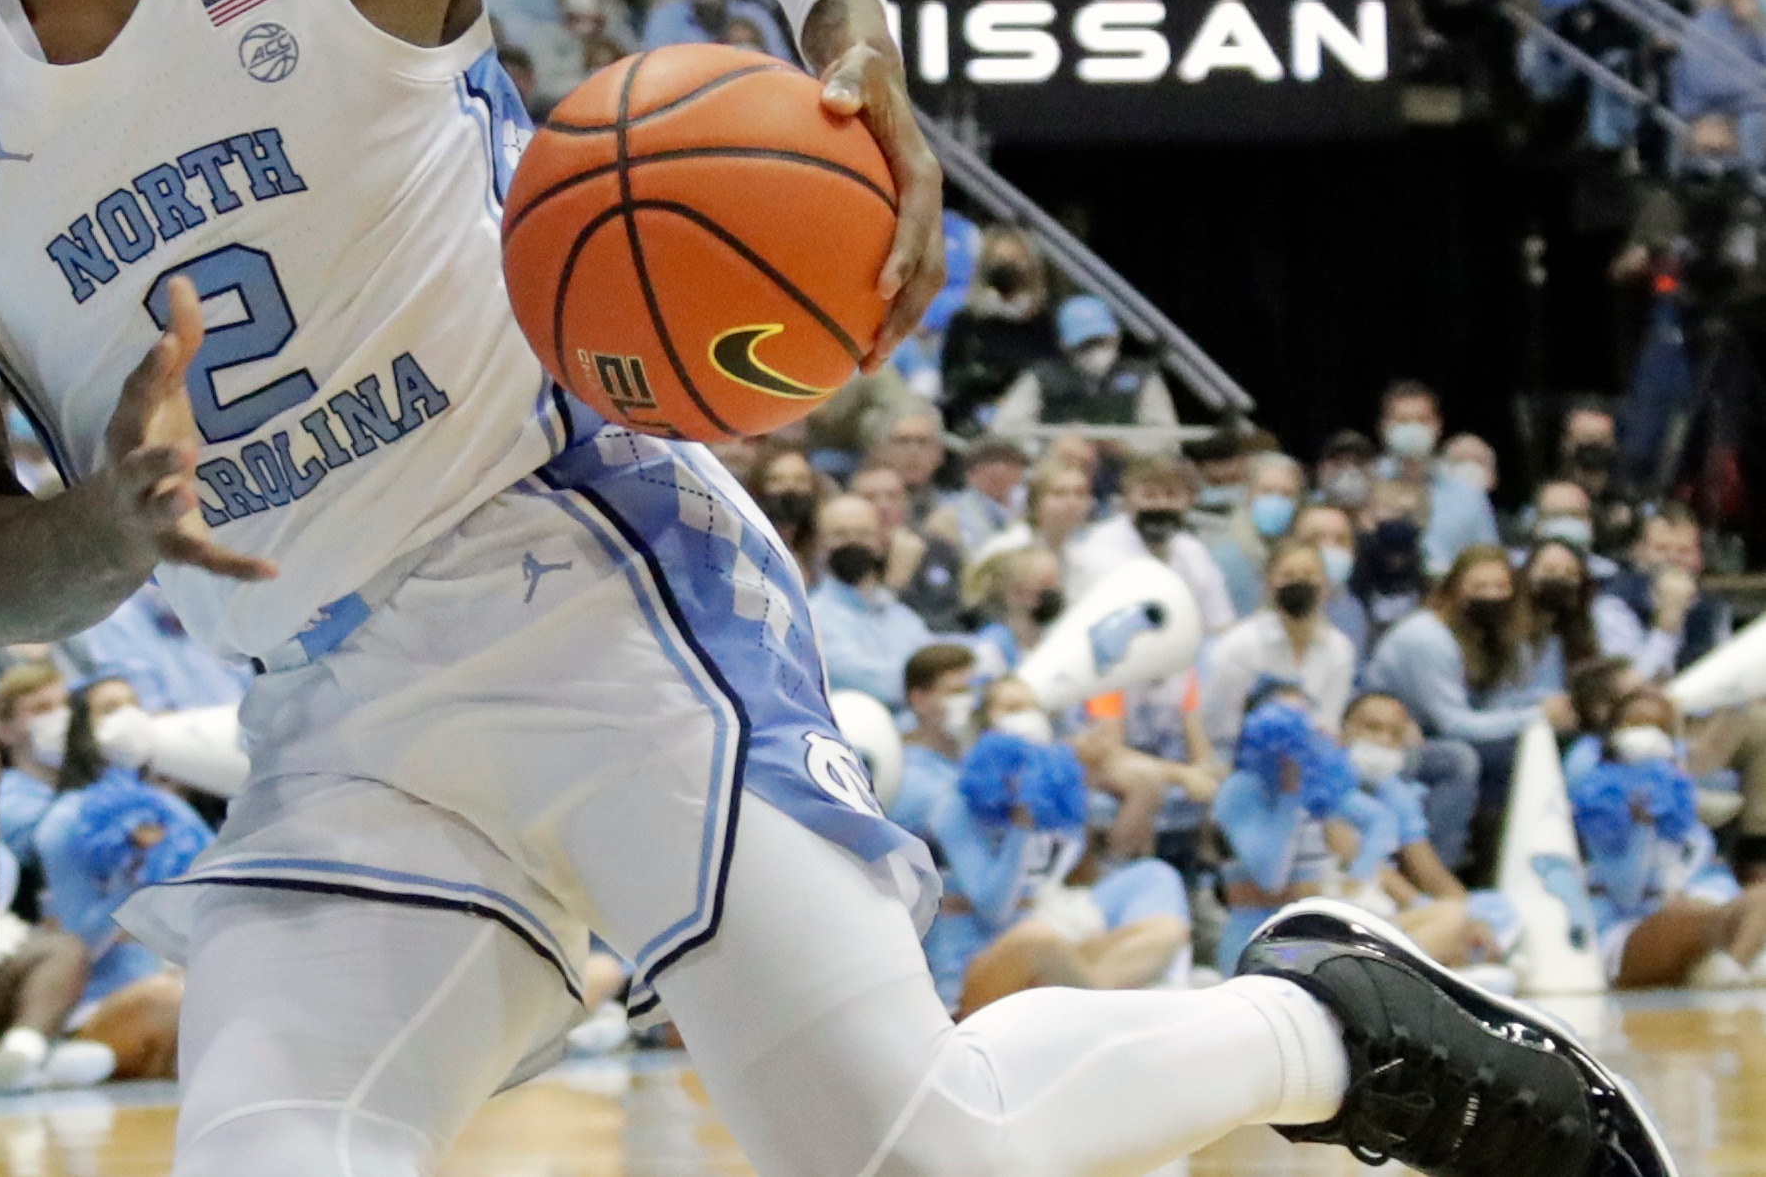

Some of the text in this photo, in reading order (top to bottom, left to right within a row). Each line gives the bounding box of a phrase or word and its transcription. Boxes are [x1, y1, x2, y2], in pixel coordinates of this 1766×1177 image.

[46, 127, 308, 305] NORTH
[142, 241, 320, 446] 2
[195, 351, 451, 528] ROLINA
